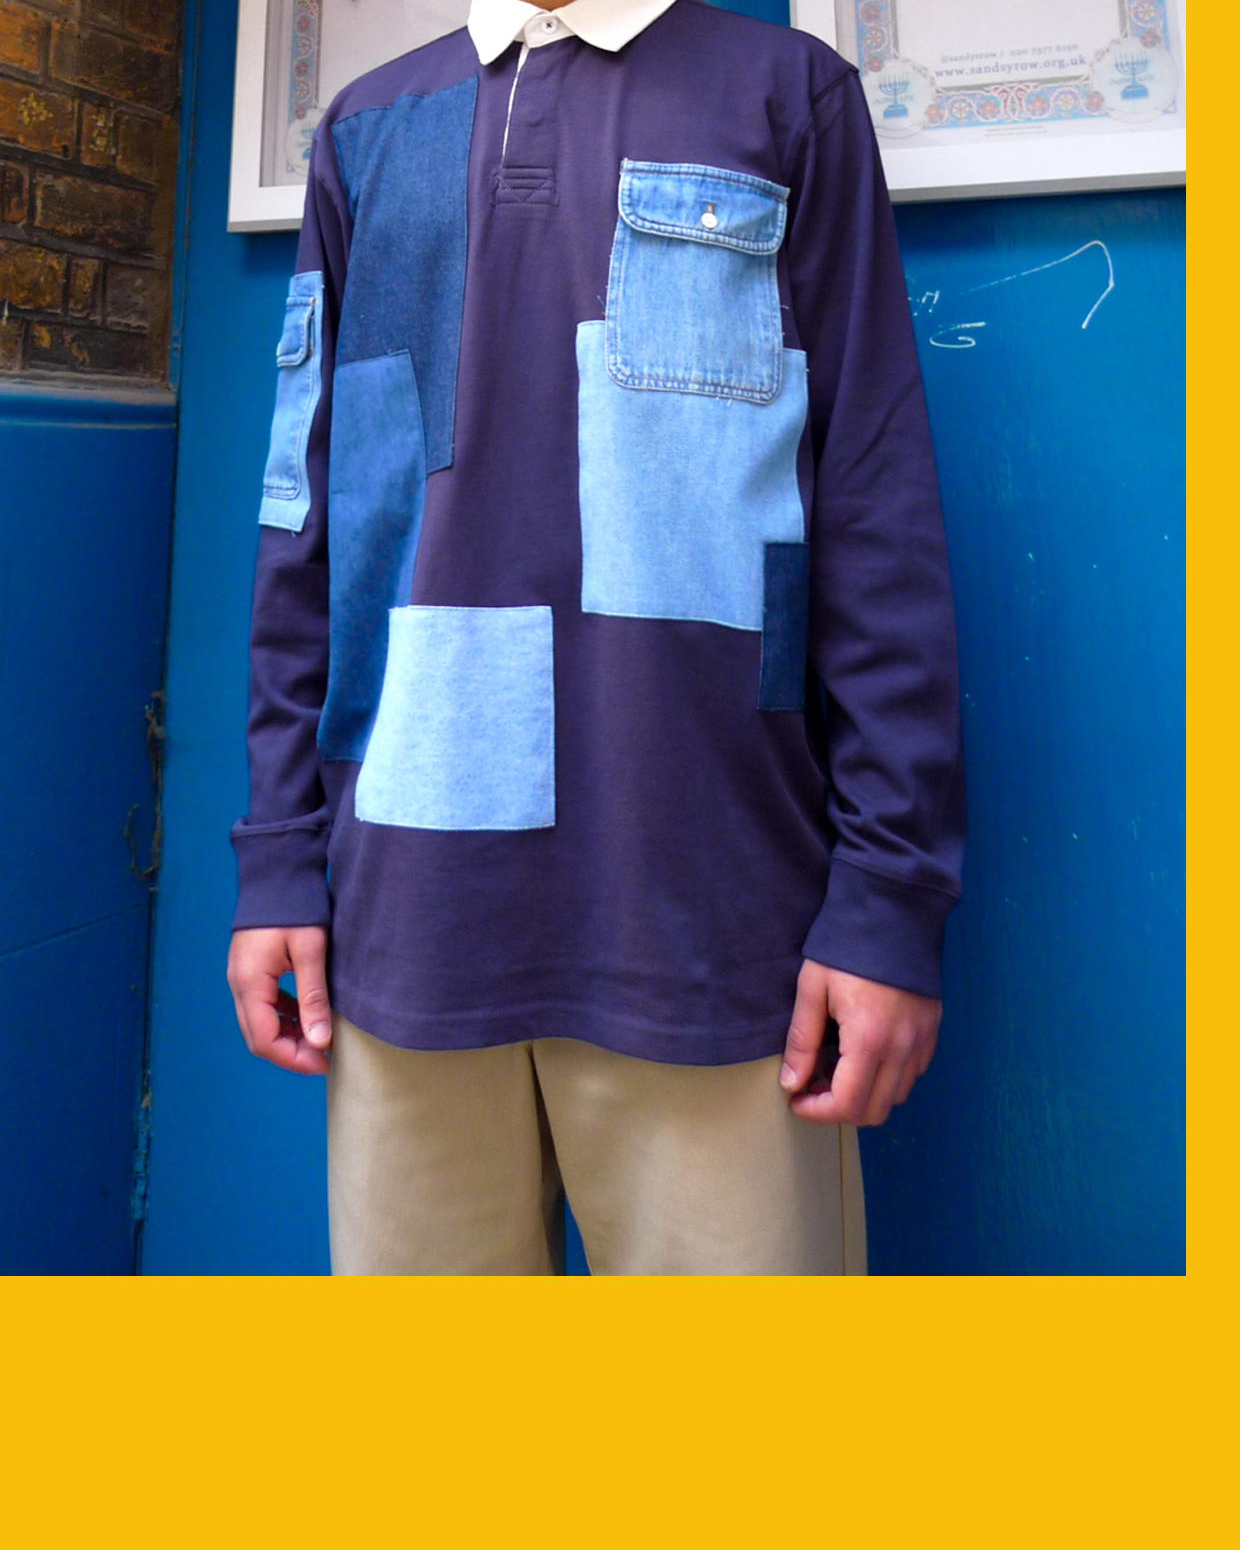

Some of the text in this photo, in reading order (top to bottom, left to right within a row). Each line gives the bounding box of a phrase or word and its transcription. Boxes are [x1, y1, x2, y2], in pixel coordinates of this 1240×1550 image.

[934, 54, 1087, 78] www.sandsyrow.org.uk
[940, 52, 997, 64] @sandysrow
[1009, 49, 1029, 57] 020
